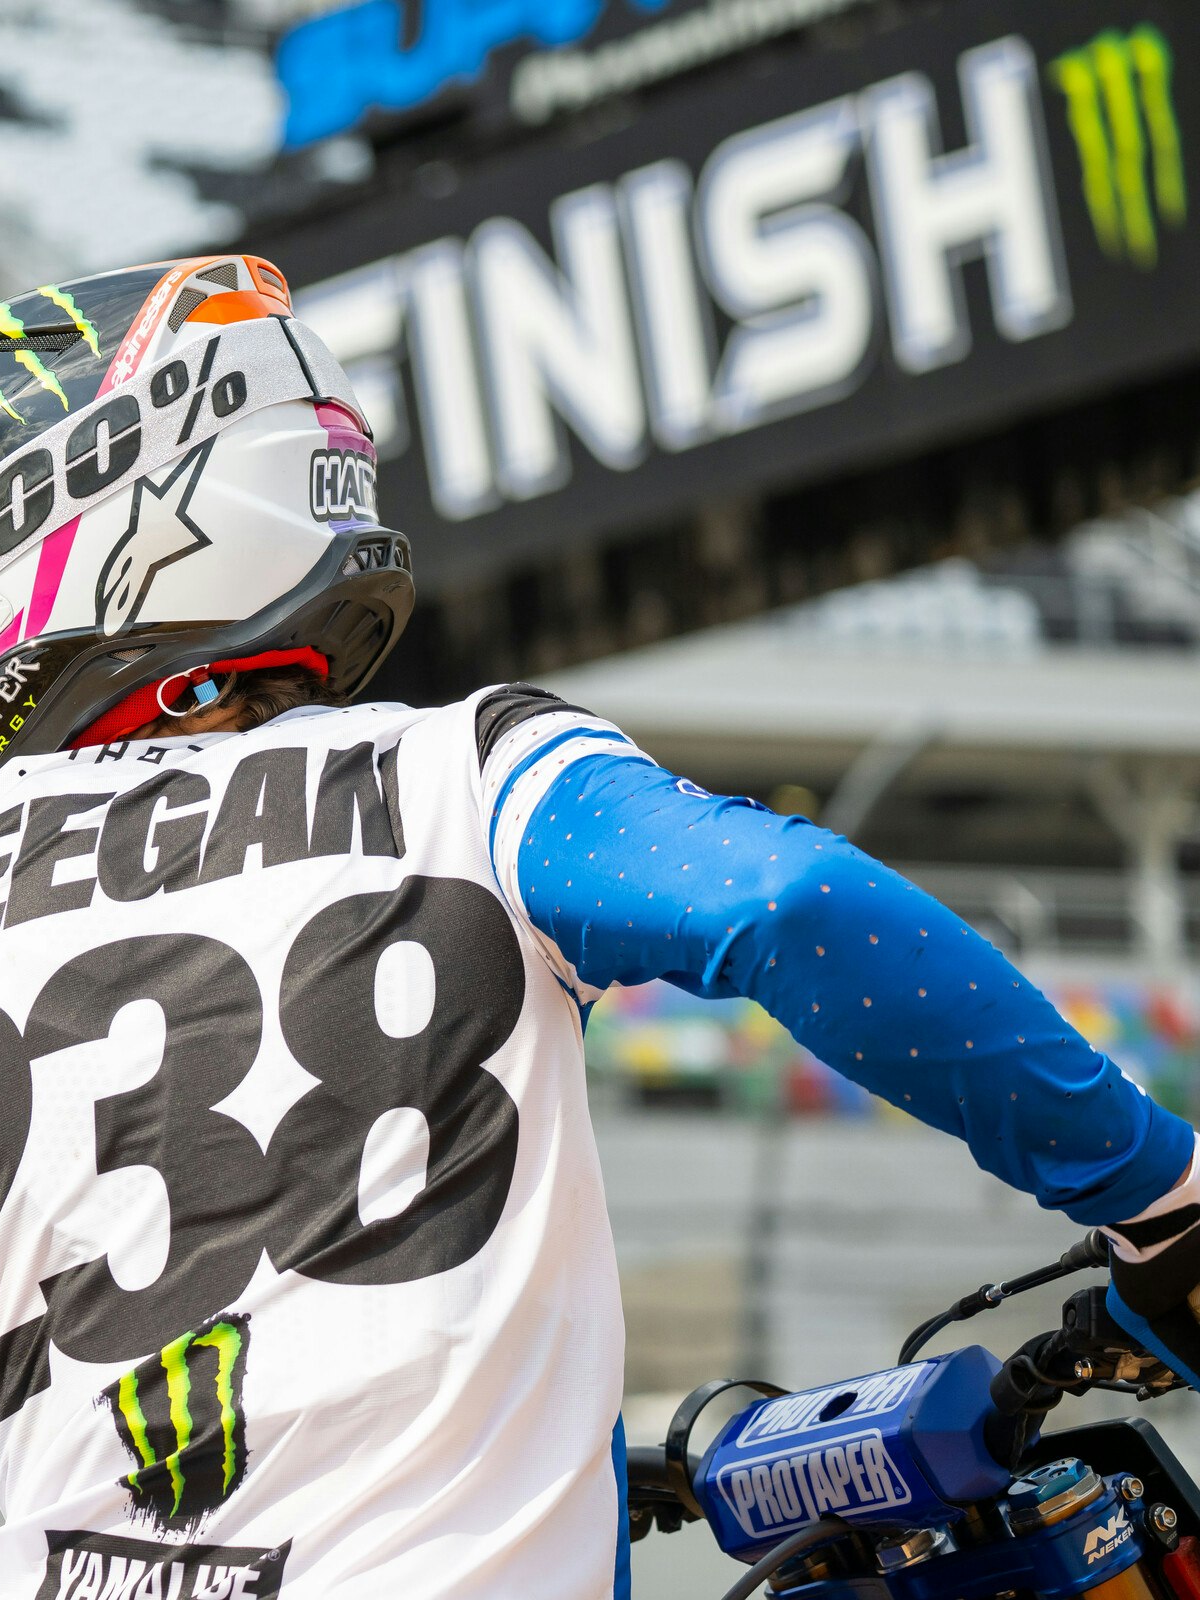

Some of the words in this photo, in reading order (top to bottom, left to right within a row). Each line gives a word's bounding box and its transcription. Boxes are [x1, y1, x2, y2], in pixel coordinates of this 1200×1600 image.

[110, 270, 183, 388] alpinestars
[730, 1437, 897, 1530] PROTAPER
[1087, 1522, 1135, 1565] NEKEN
